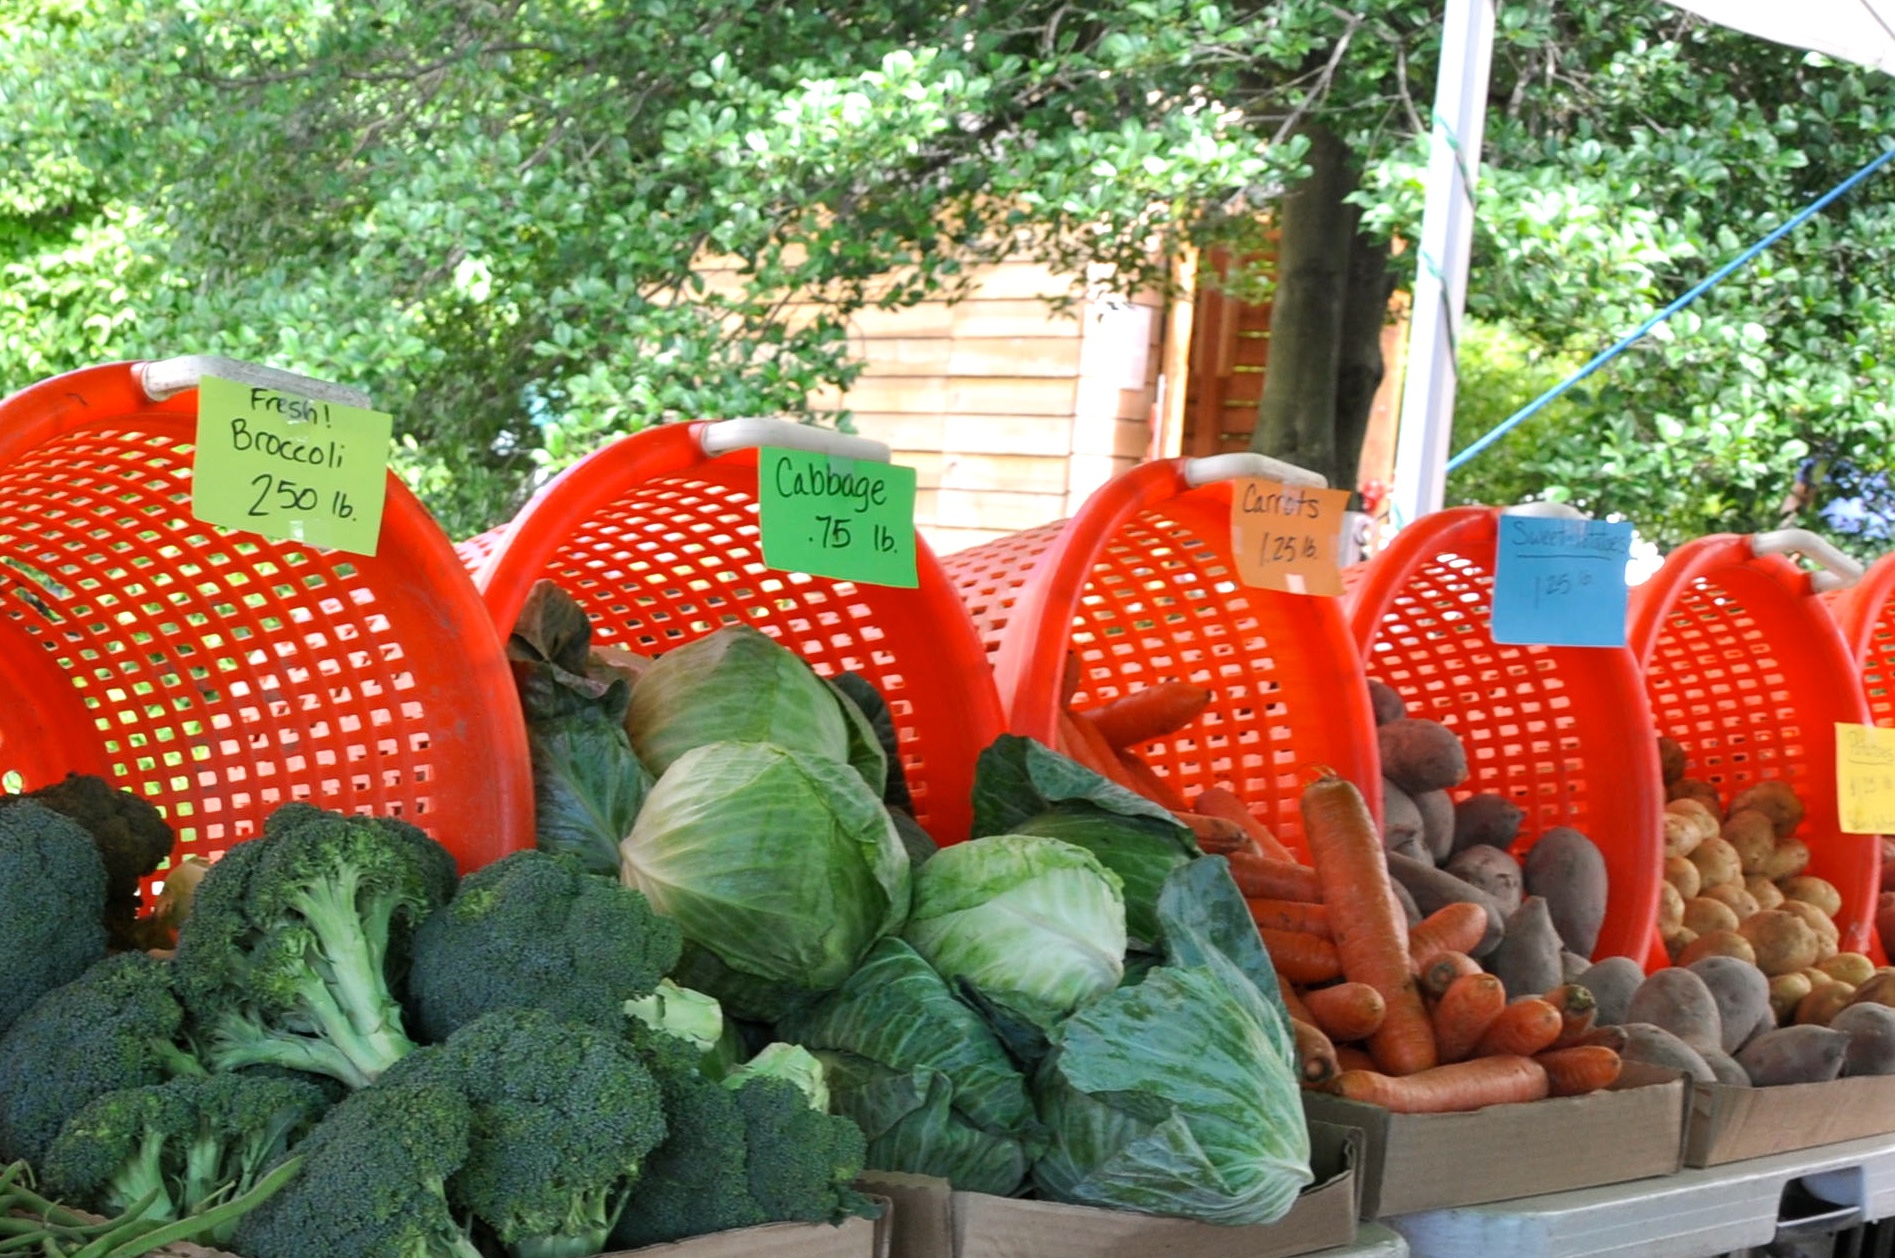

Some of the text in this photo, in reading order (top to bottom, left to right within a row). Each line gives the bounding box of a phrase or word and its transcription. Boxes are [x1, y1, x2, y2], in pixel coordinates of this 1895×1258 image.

[251, 388, 332, 429] Fresh!
[231, 418, 346, 469] Broccoli
[776, 457, 887, 513] Cabbage
[1243, 483, 1320, 519] Carrots
